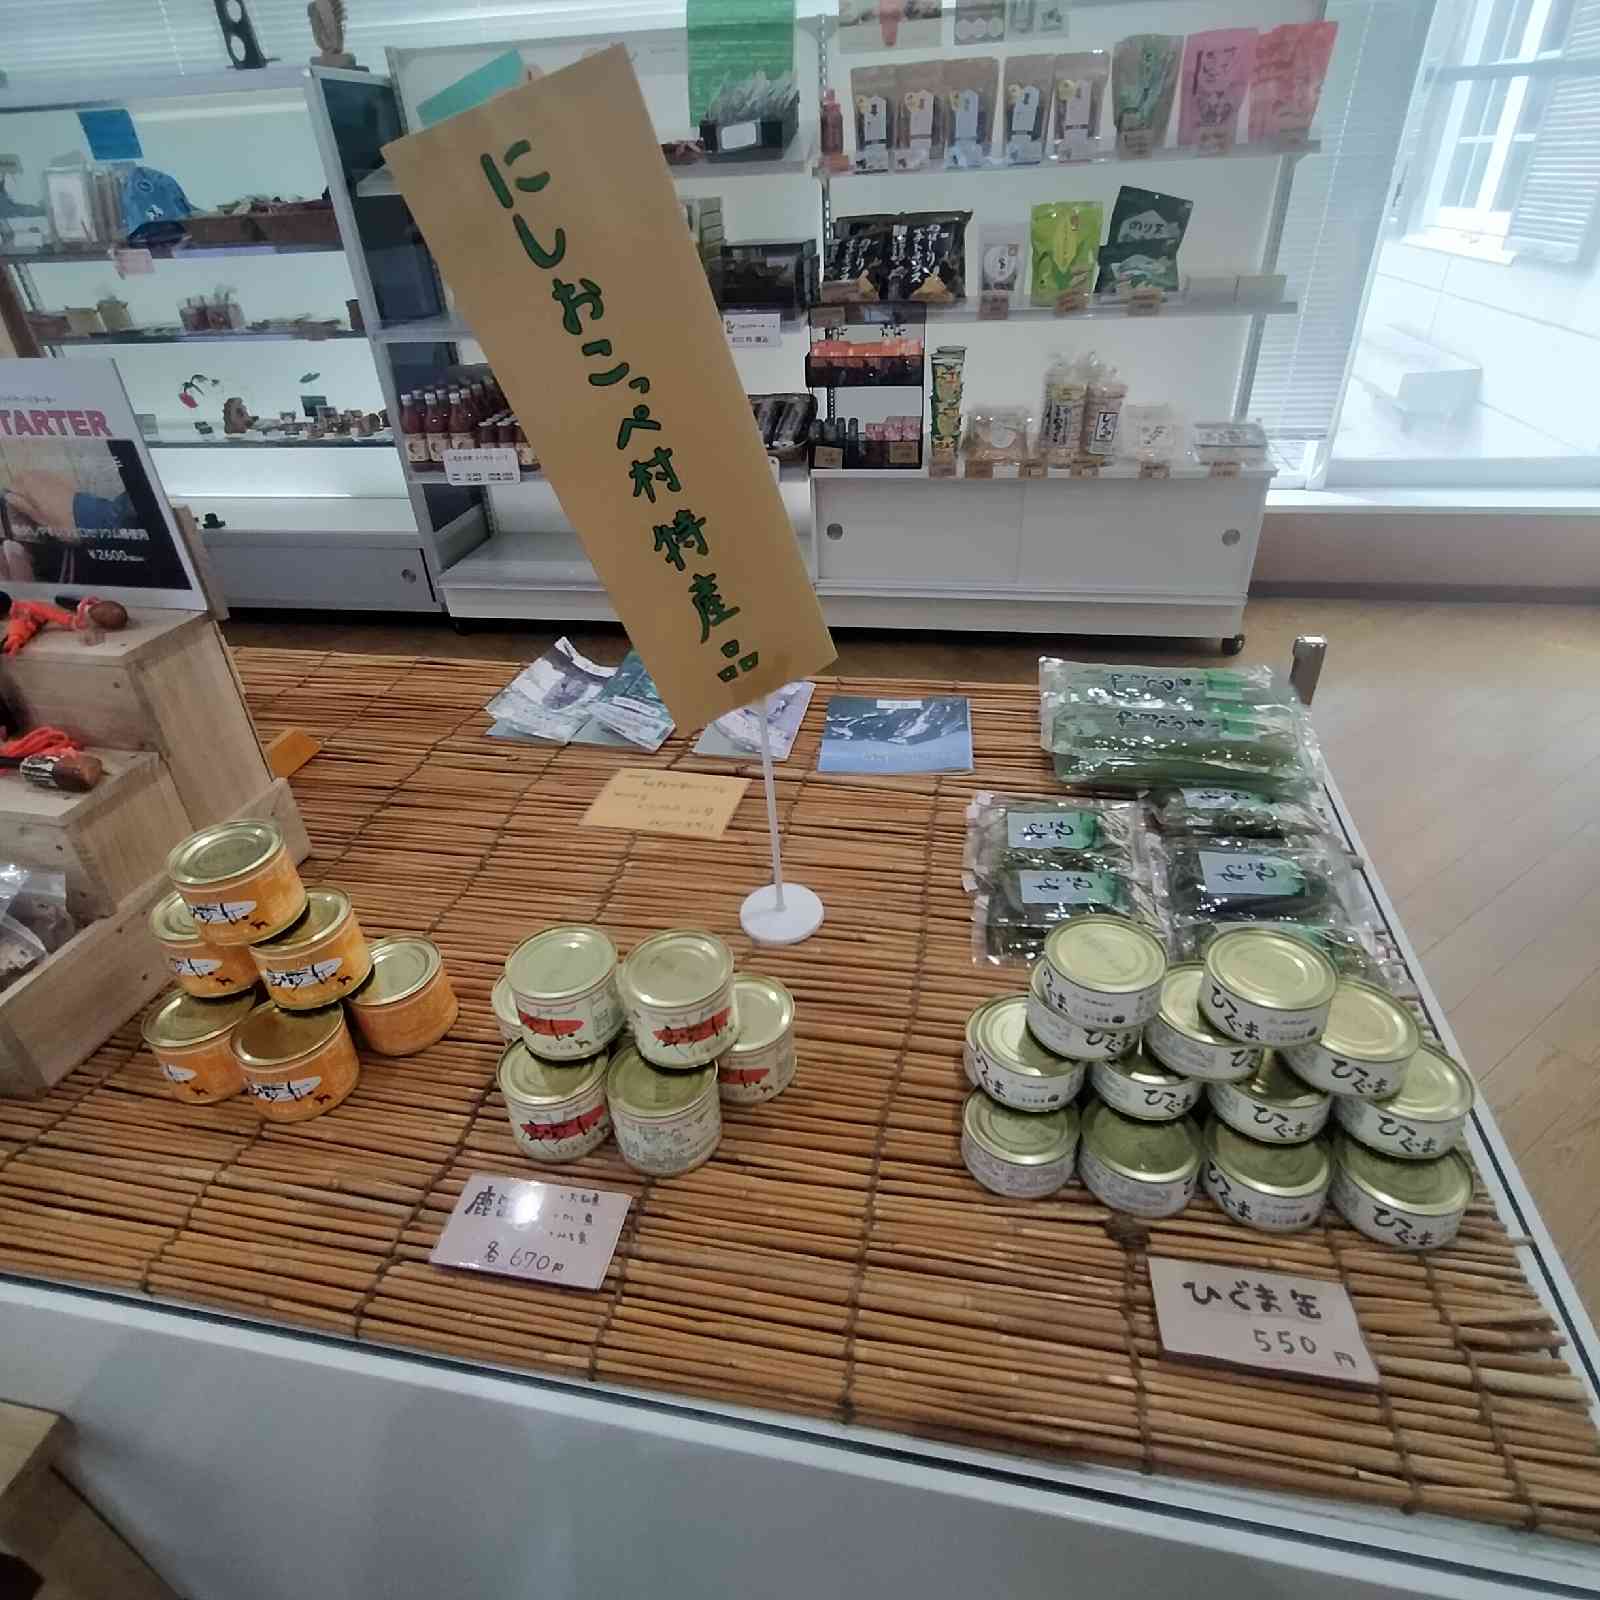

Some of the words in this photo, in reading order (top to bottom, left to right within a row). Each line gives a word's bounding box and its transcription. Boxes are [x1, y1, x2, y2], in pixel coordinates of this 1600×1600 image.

[480, 139, 759, 683] にしおこっぺ村特産品
[1211, 984, 1261, 1041] ひぐま
[1330, 1058, 1390, 1094] ひぐま
[1252, 1103, 1309, 1138] ひぐま
[1377, 1113, 1437, 1153] ひぐま
[1371, 1202, 1433, 1247] ひぐま
